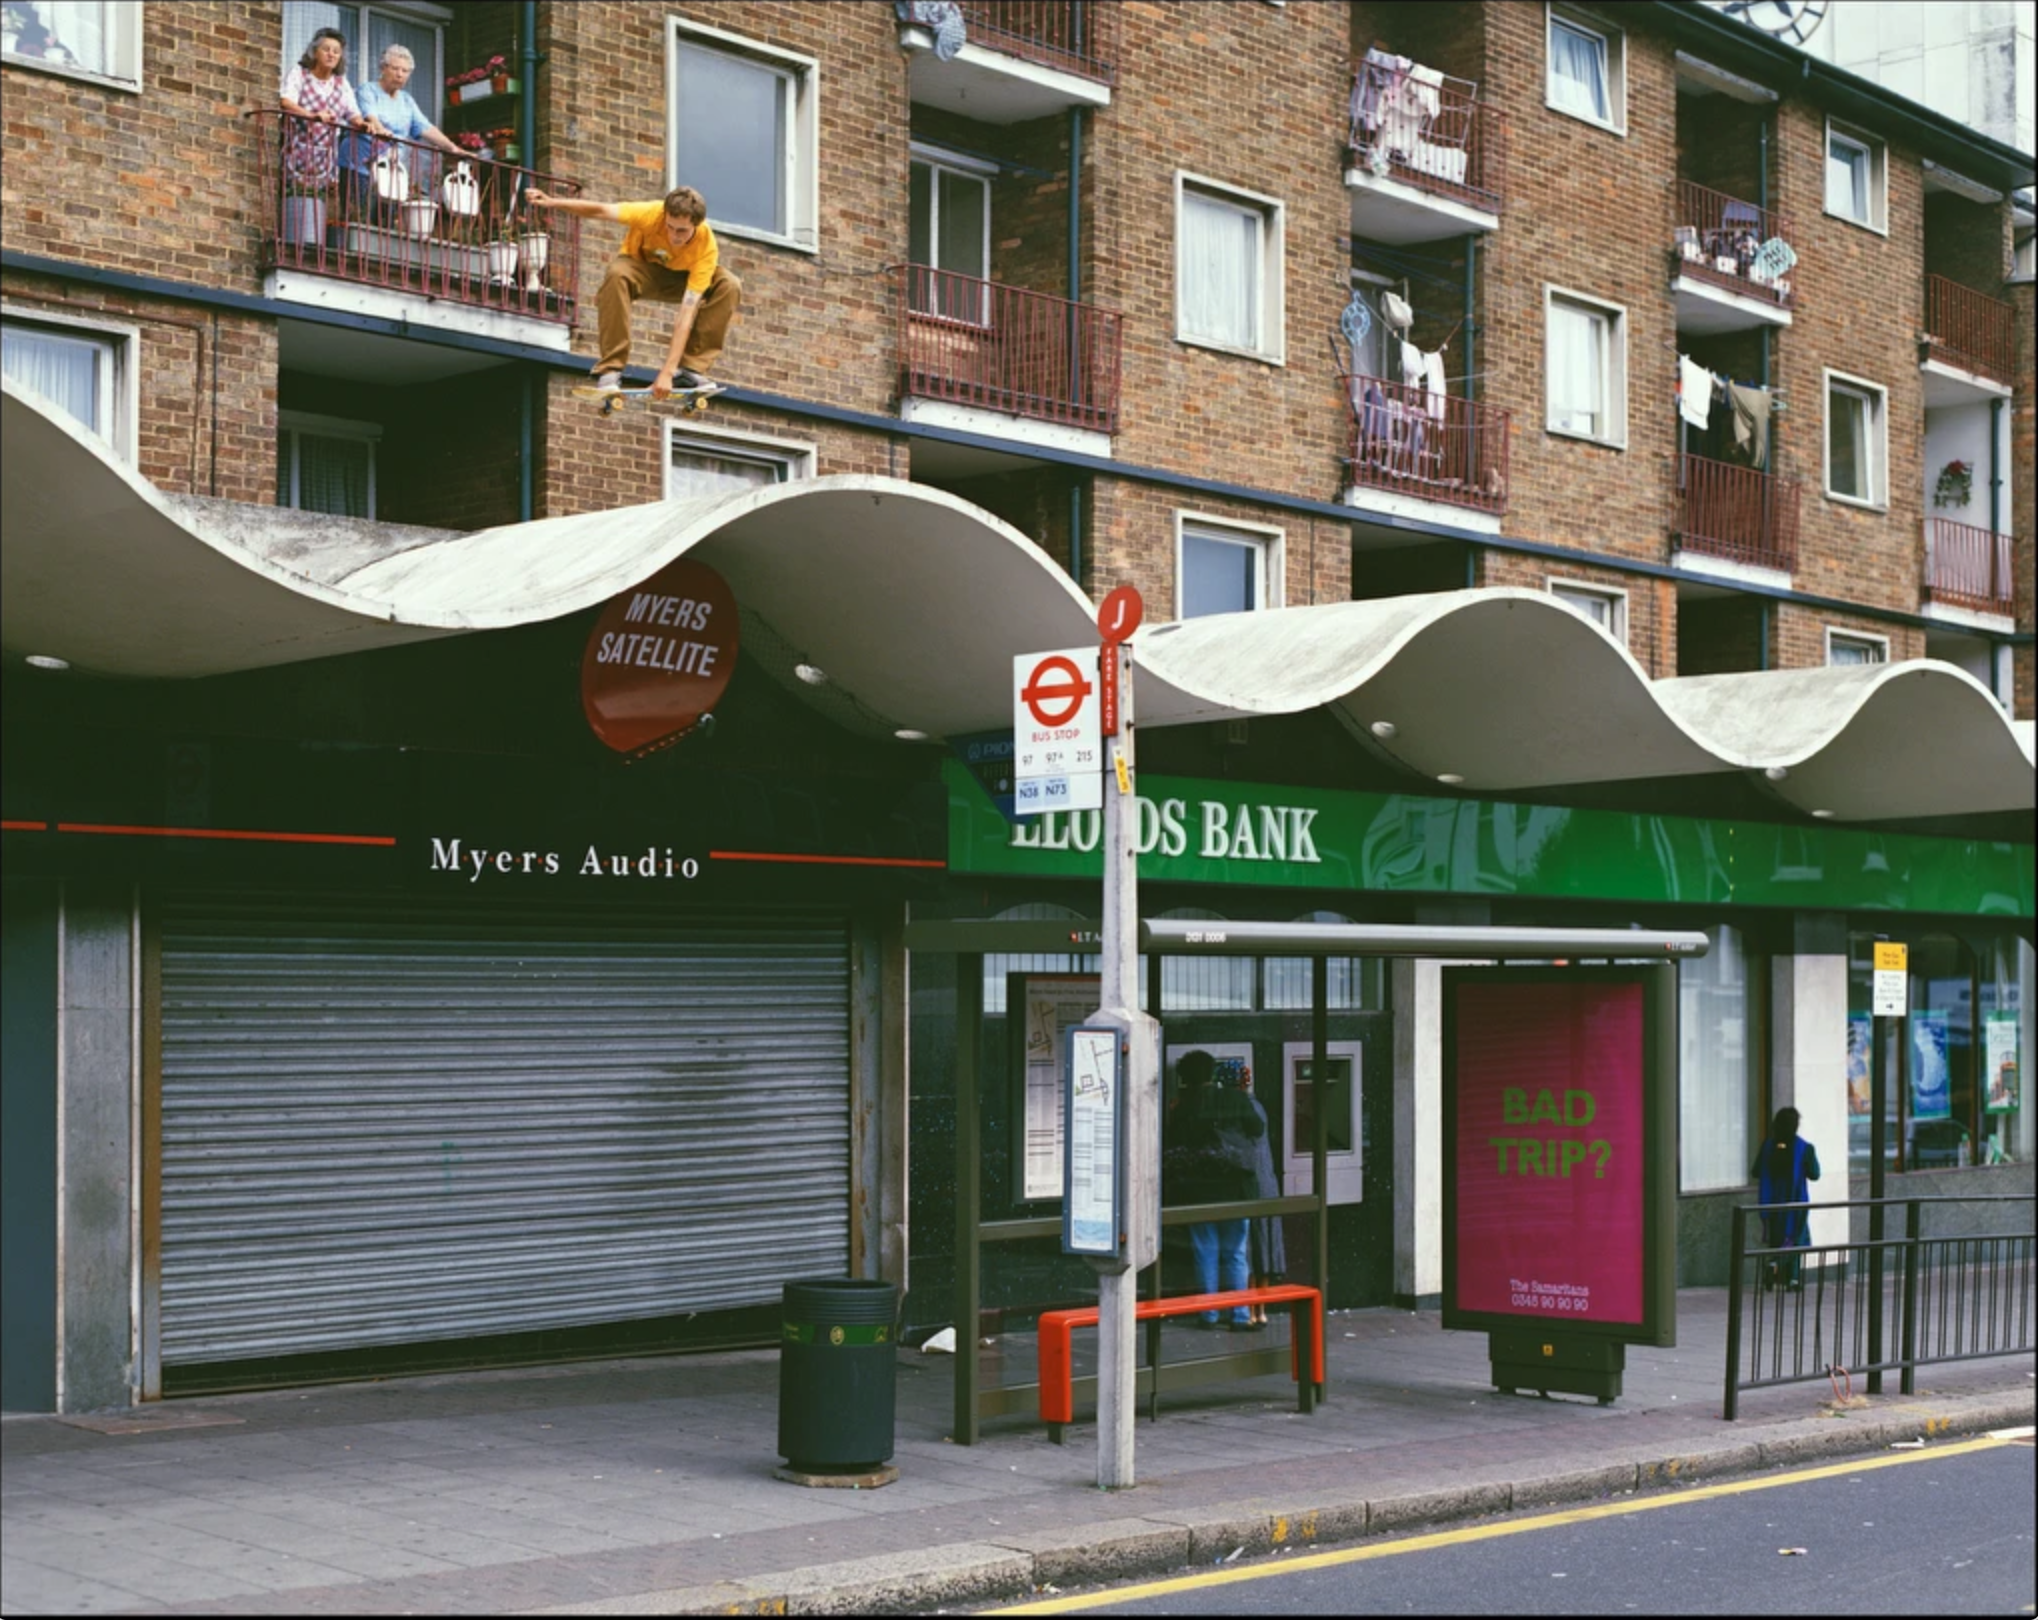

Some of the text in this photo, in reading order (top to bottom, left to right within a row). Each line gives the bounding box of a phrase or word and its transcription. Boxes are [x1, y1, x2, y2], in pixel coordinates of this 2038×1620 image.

[624, 592, 713, 631] MYERS
[1110, 599, 1126, 630] J
[596, 631, 719, 677] SATELLITE
[1105, 647, 1114, 729] FARE STAGE
[1031, 728, 1080, 743] BUS STOP
[1022, 755, 1033, 766] 97
[1076, 750, 1093, 762] 215
[1019, 787, 1039, 799] N38
[1045, 783, 1067, 796] N73
[1010, 796, 1322, 863] LLODS BANK
[1502, 1088, 1597, 1127] BAD
[1489, 1137, 1613, 1180] TRIP?
[1510, 1279, 1590, 1297] The Samaritans
[1541, 1296, 1555, 1309] 90
[1558, 1297, 1572, 1310] 90
[1574, 1298, 1589, 1312] 90
